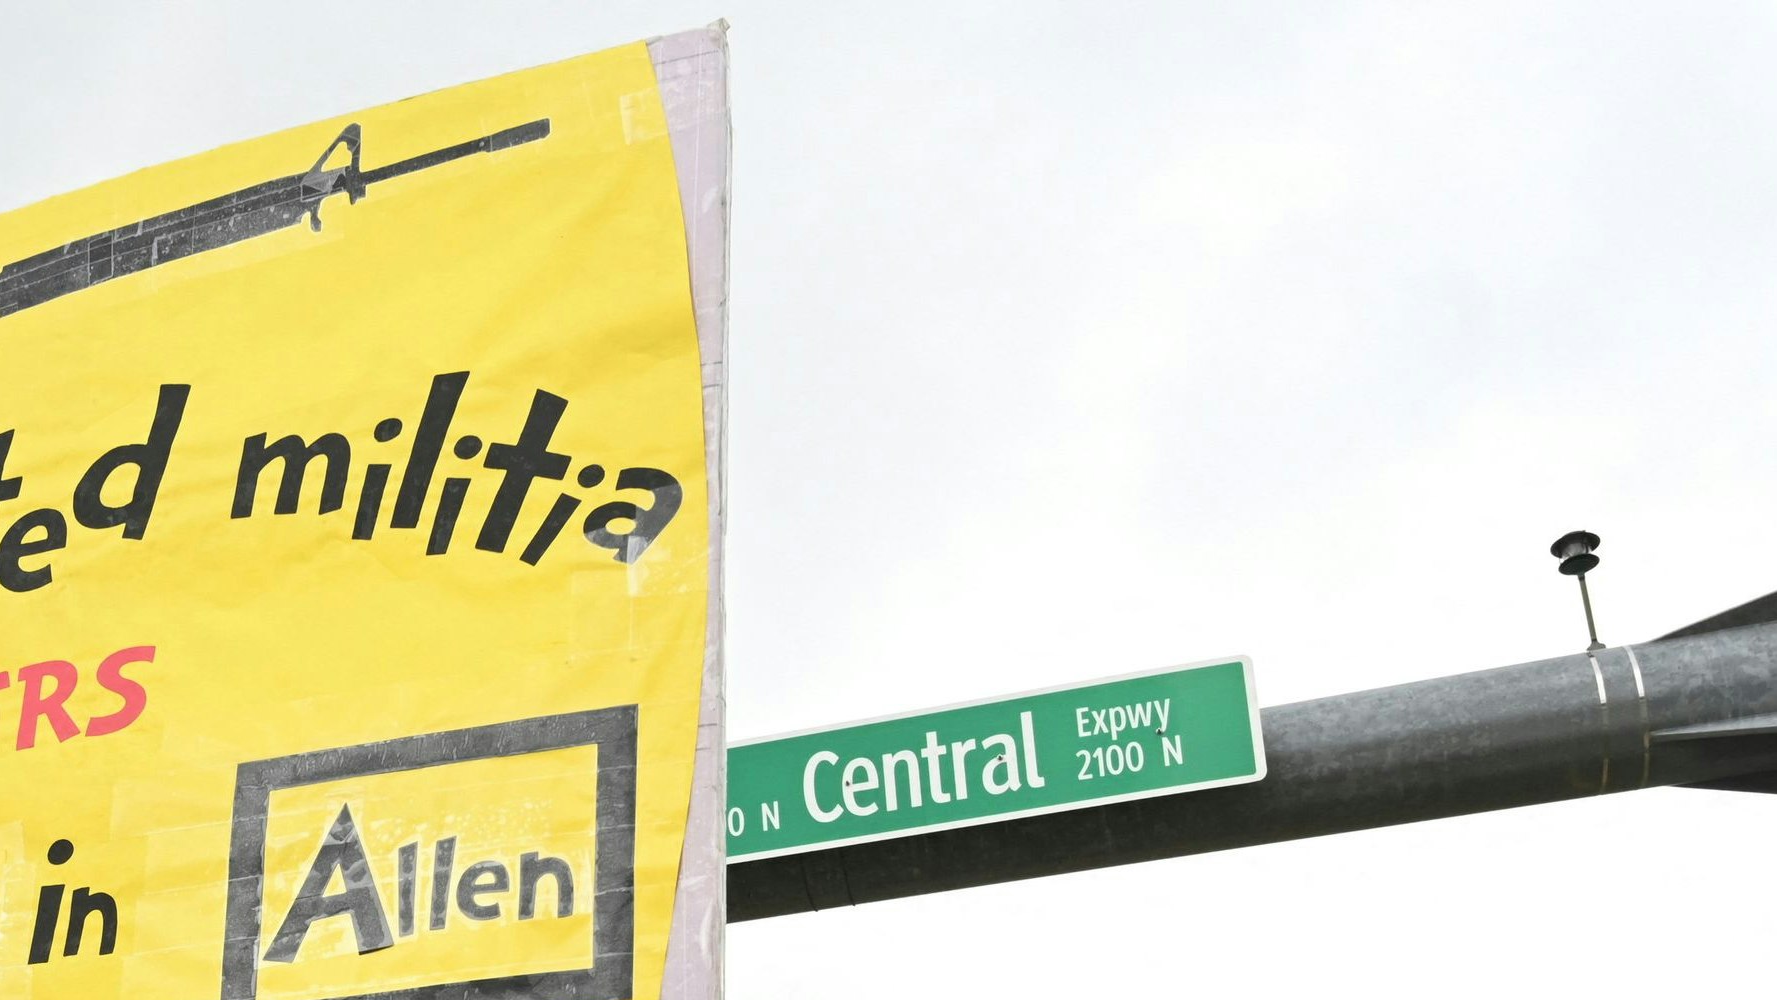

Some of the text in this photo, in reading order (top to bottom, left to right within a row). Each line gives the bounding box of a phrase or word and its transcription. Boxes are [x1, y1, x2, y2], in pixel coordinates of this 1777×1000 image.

[229, 370, 683, 565] militia
[1075, 698, 1171, 741] Expwy
[1075, 734, 1184, 781] 2100 N
[802, 710, 1046, 824] Central
[761, 800, 781, 832] N
[27, 838, 118, 965] in
[262, 802, 575, 964] Allen
